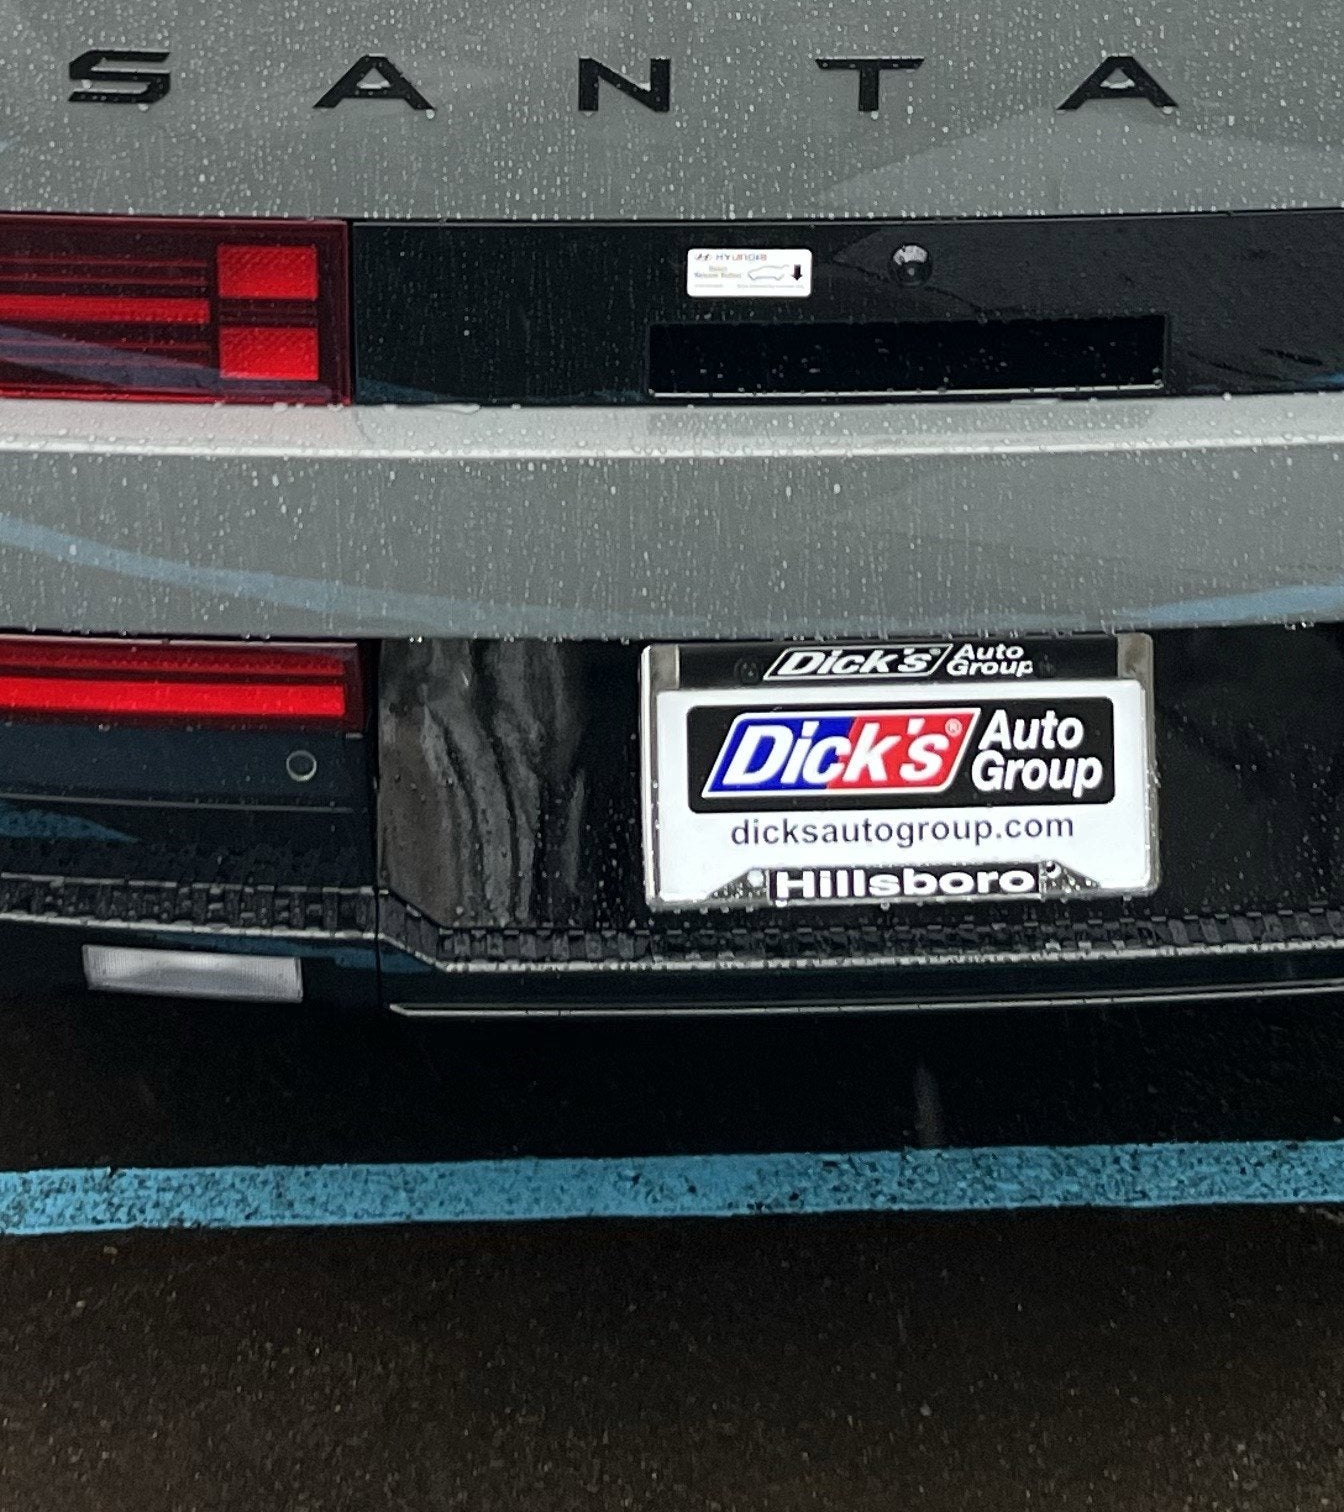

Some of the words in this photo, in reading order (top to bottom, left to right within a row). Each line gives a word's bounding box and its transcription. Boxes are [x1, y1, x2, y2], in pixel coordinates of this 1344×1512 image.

[67, 47, 1180, 113] SANTA
[777, 648, 933, 676] Dick's
[946, 658, 1034, 678] Group
[953, 643, 1025, 661] Auto
[978, 709, 1084, 751] Auto
[721, 717, 951, 787] Dick's
[971, 749, 1103, 798] Group
[730, 817, 1075, 848] dicksautogroup.com
[775, 868, 1036, 900] Hillsboro
